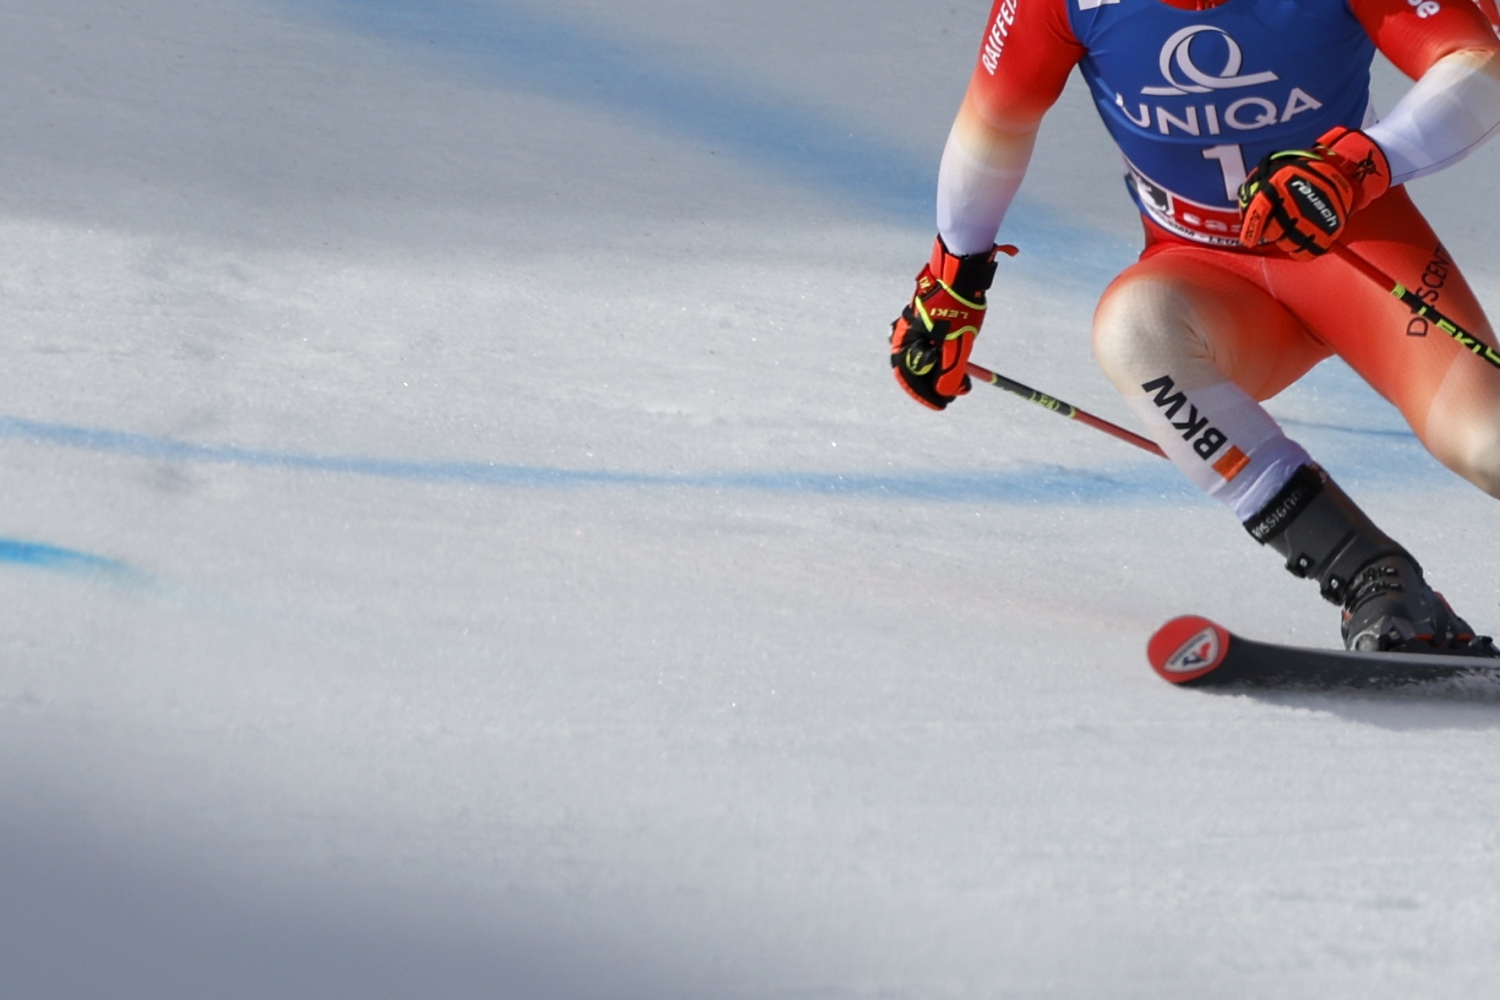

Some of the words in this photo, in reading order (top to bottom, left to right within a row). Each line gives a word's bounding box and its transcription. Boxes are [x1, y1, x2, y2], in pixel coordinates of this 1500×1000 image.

[1115, 87, 1323, 136] UNIQA
[1202, 143, 1249, 201] 1
[930, 307, 969, 320] LEKI
[1141, 375, 1228, 461] BKW
